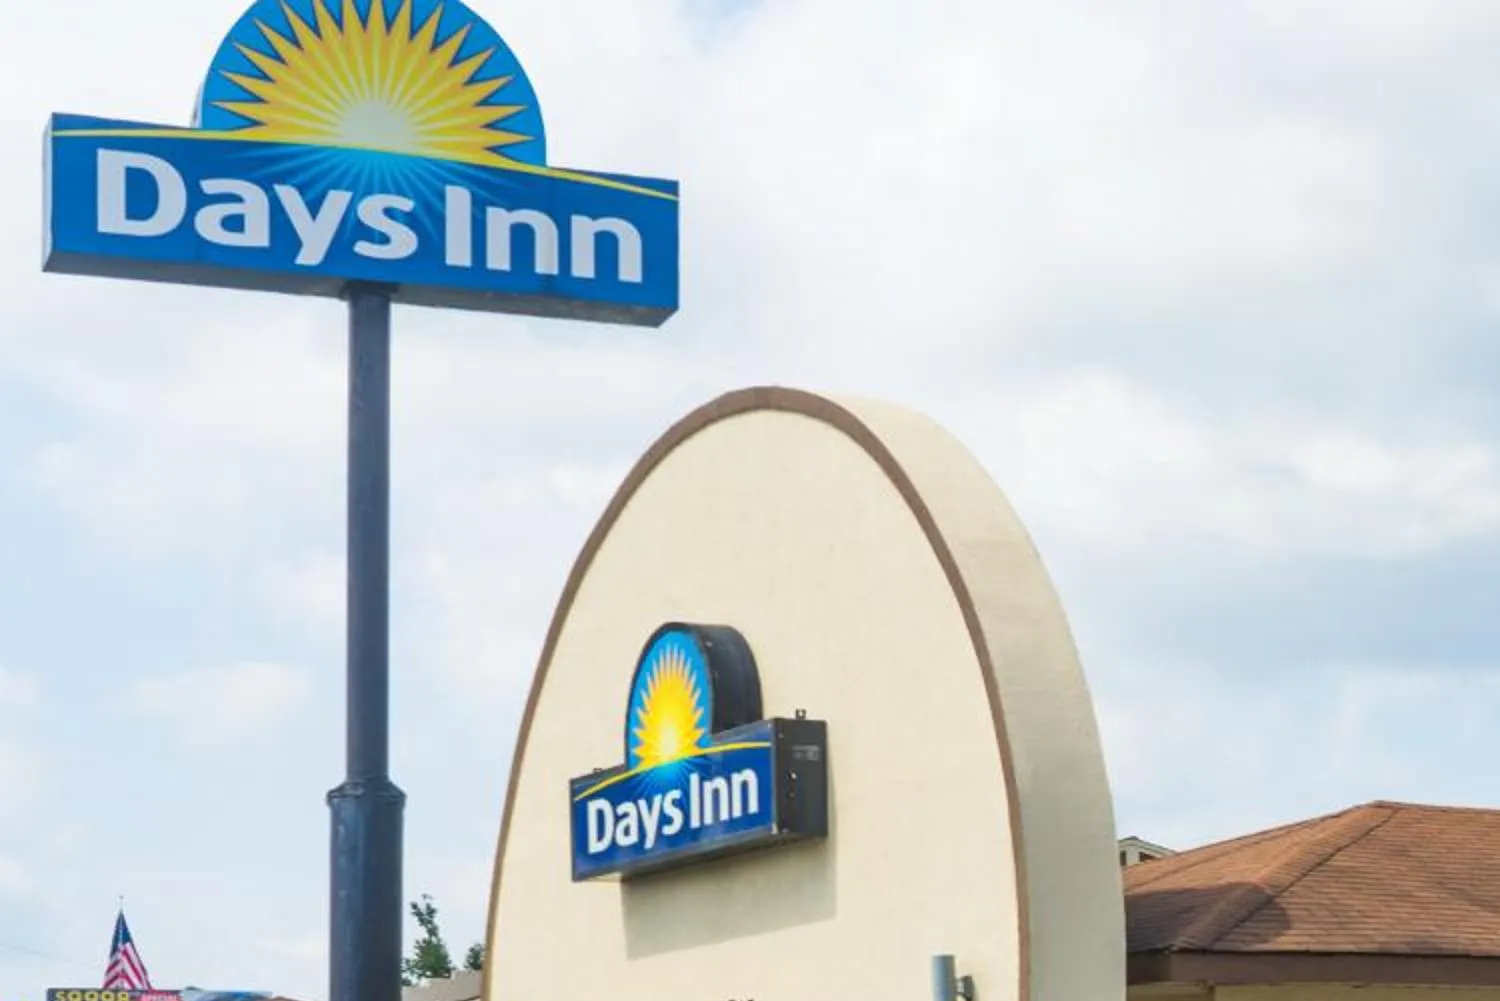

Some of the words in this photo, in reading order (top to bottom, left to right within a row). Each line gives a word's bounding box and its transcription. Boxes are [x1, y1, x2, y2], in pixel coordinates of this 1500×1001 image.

[96, 147, 419, 265] Days
[445, 185, 643, 283] Inn
[586, 788, 684, 855] Days
[689, 767, 759, 829] Inn
